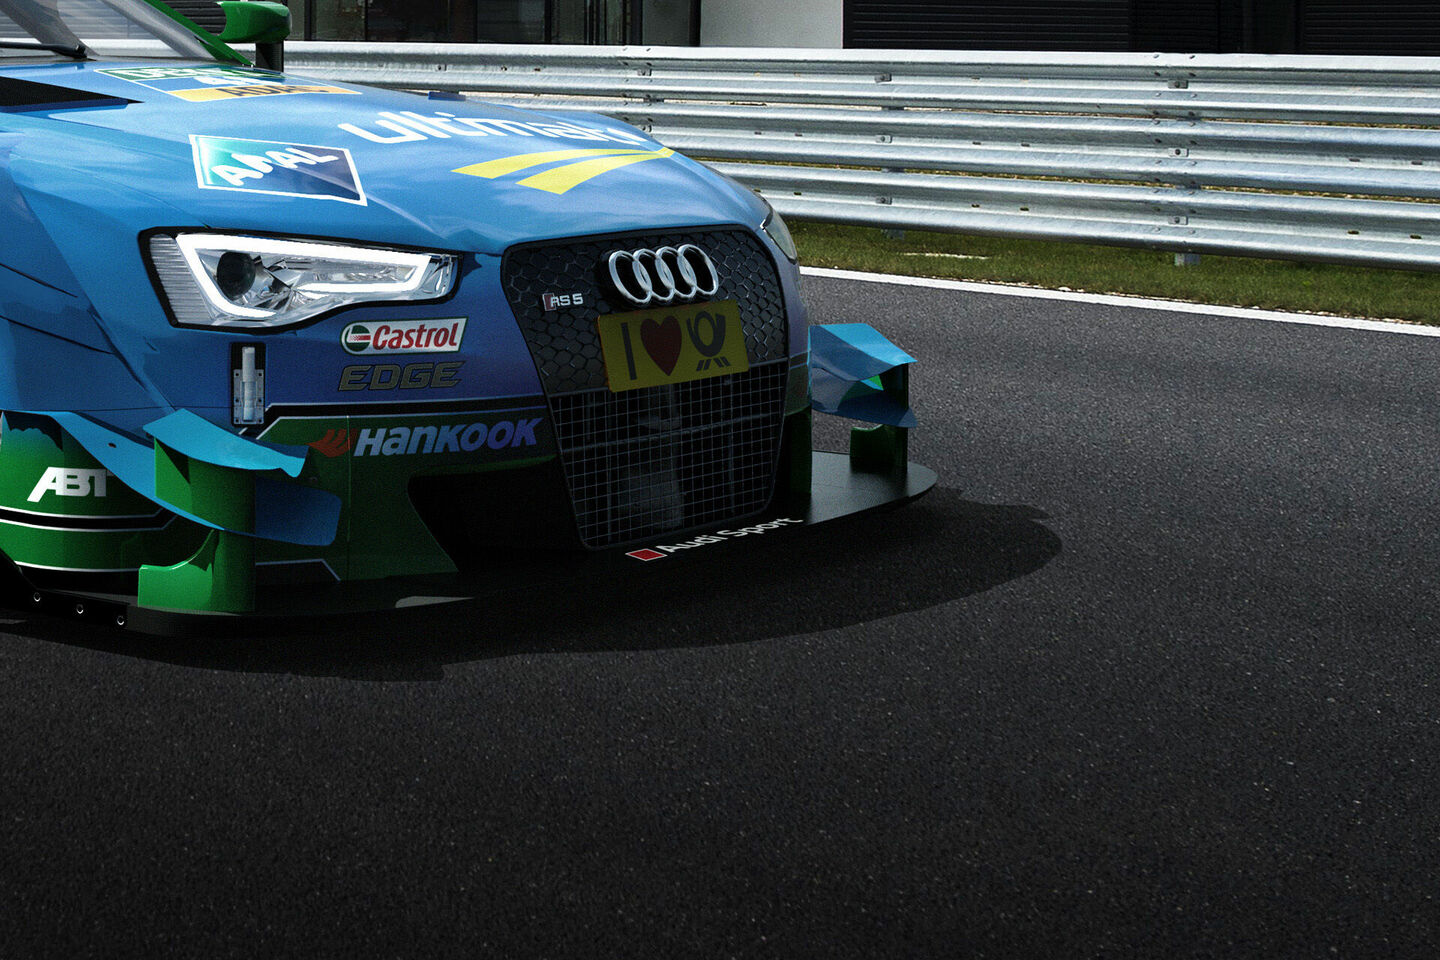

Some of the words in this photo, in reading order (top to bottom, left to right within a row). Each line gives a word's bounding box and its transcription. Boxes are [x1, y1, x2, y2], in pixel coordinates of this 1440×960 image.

[372, 321, 460, 351] Castrol
[338, 360, 467, 391] EDGE
[27, 466, 112, 503] ABT
[656, 534, 729, 553] Audi
[716, 518, 804, 538] Sport
